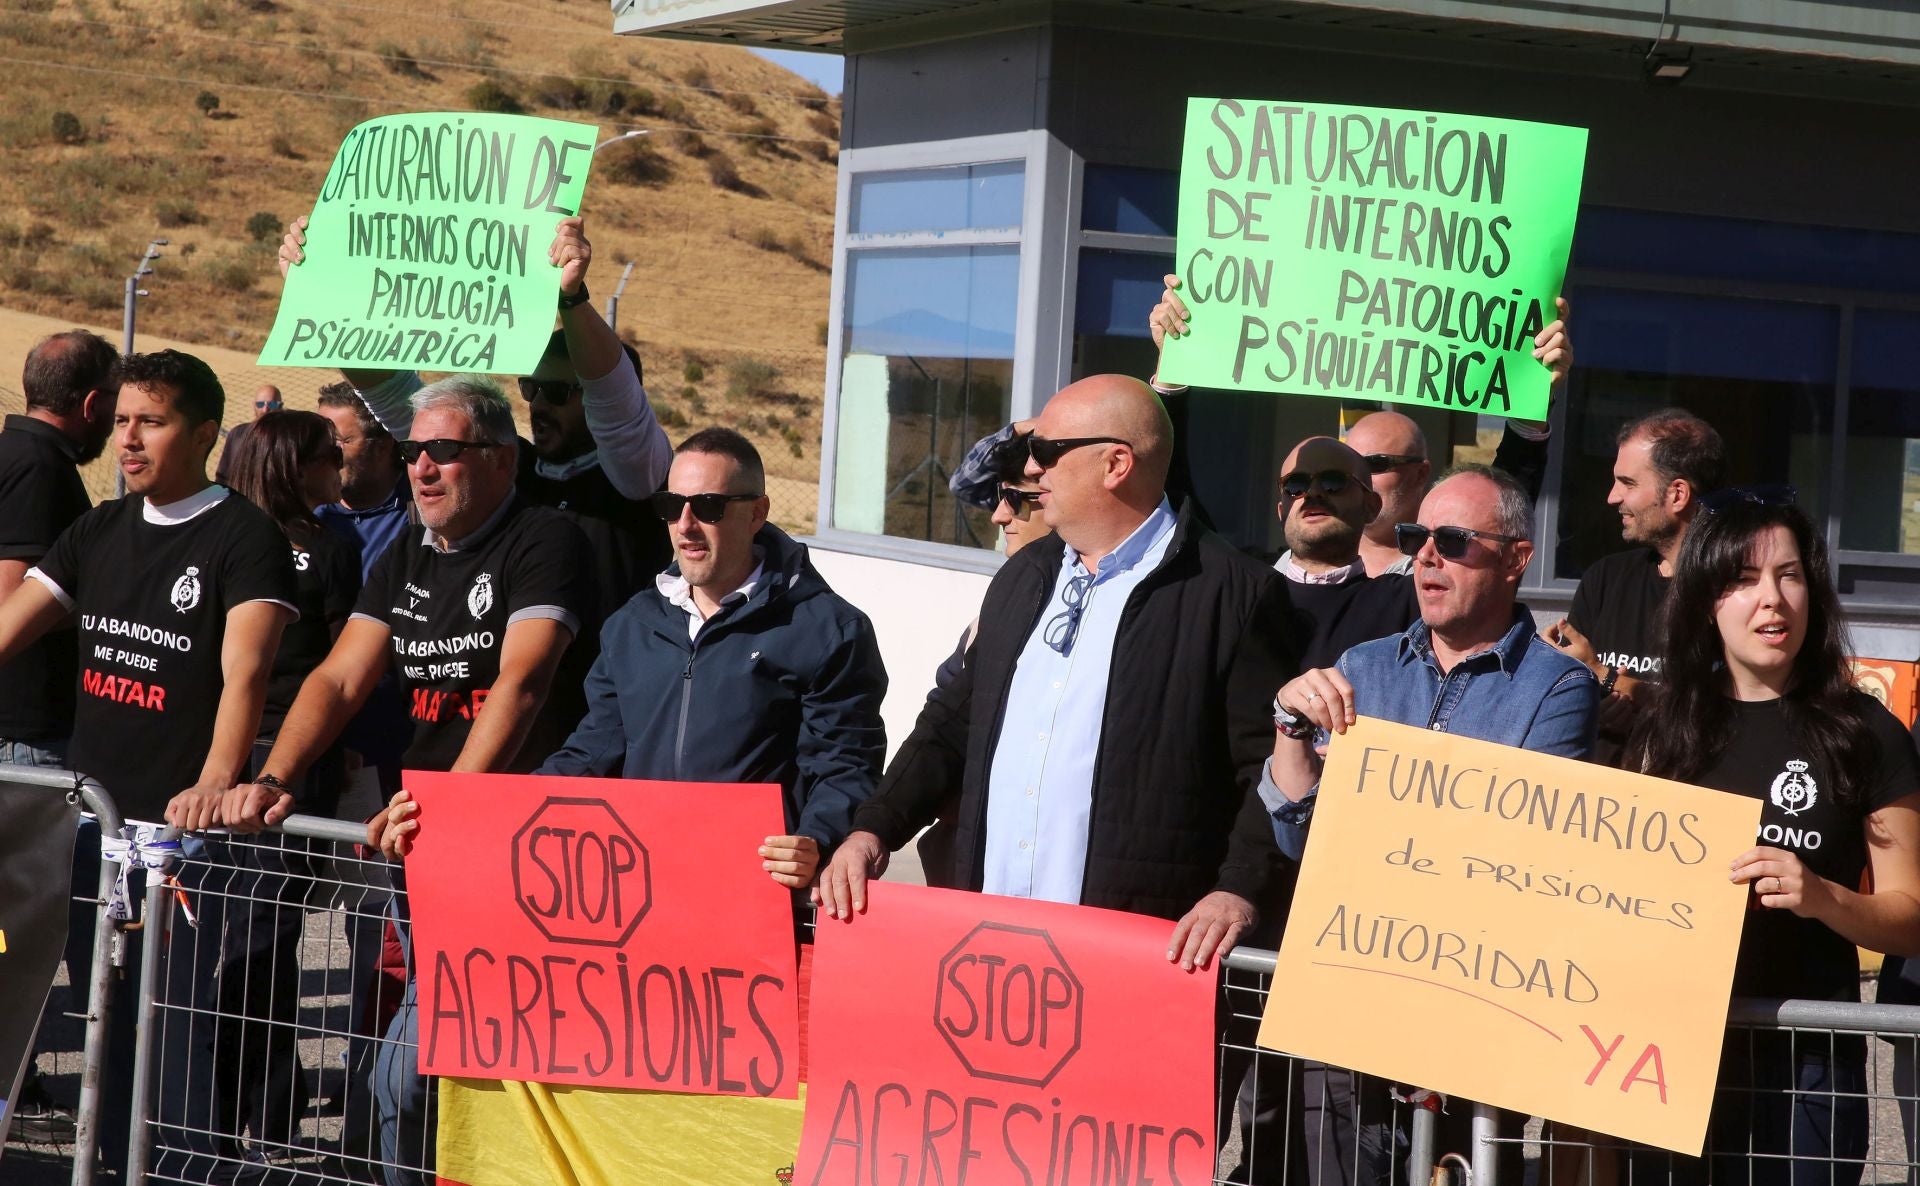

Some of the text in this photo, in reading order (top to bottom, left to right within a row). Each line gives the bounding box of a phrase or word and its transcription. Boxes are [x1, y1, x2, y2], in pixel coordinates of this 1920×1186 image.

[523, 135, 592, 216] DE
[348, 204, 530, 277] INTERNOS CON
[1207, 186, 1512, 278] DE INTERNOS
[1187, 248, 1274, 308] CON
[97, 617, 192, 652] ABANDONO
[403, 609, 414, 619] DEL
[414, 614, 428, 622] REAL
[409, 597, 420, 609] V
[94, 645, 158, 672] ME PUEDE
[392, 635, 405, 654] TU
[404, 665, 428, 680] ME
[83, 669, 166, 712] MATAR
[1356, 746, 1708, 865] FUNCIONARIOS
[526, 826, 637, 928] STOP
[1385, 837, 1695, 930] de PRISIONES
[1315, 904, 1599, 1004] AUTORIDAD
[426, 948, 785, 1097] AGRESIONES
[943, 953, 1072, 1049] STOP
[1579, 1024, 1669, 1105] YA
[811, 1079, 1206, 1186] AGRESIONES
